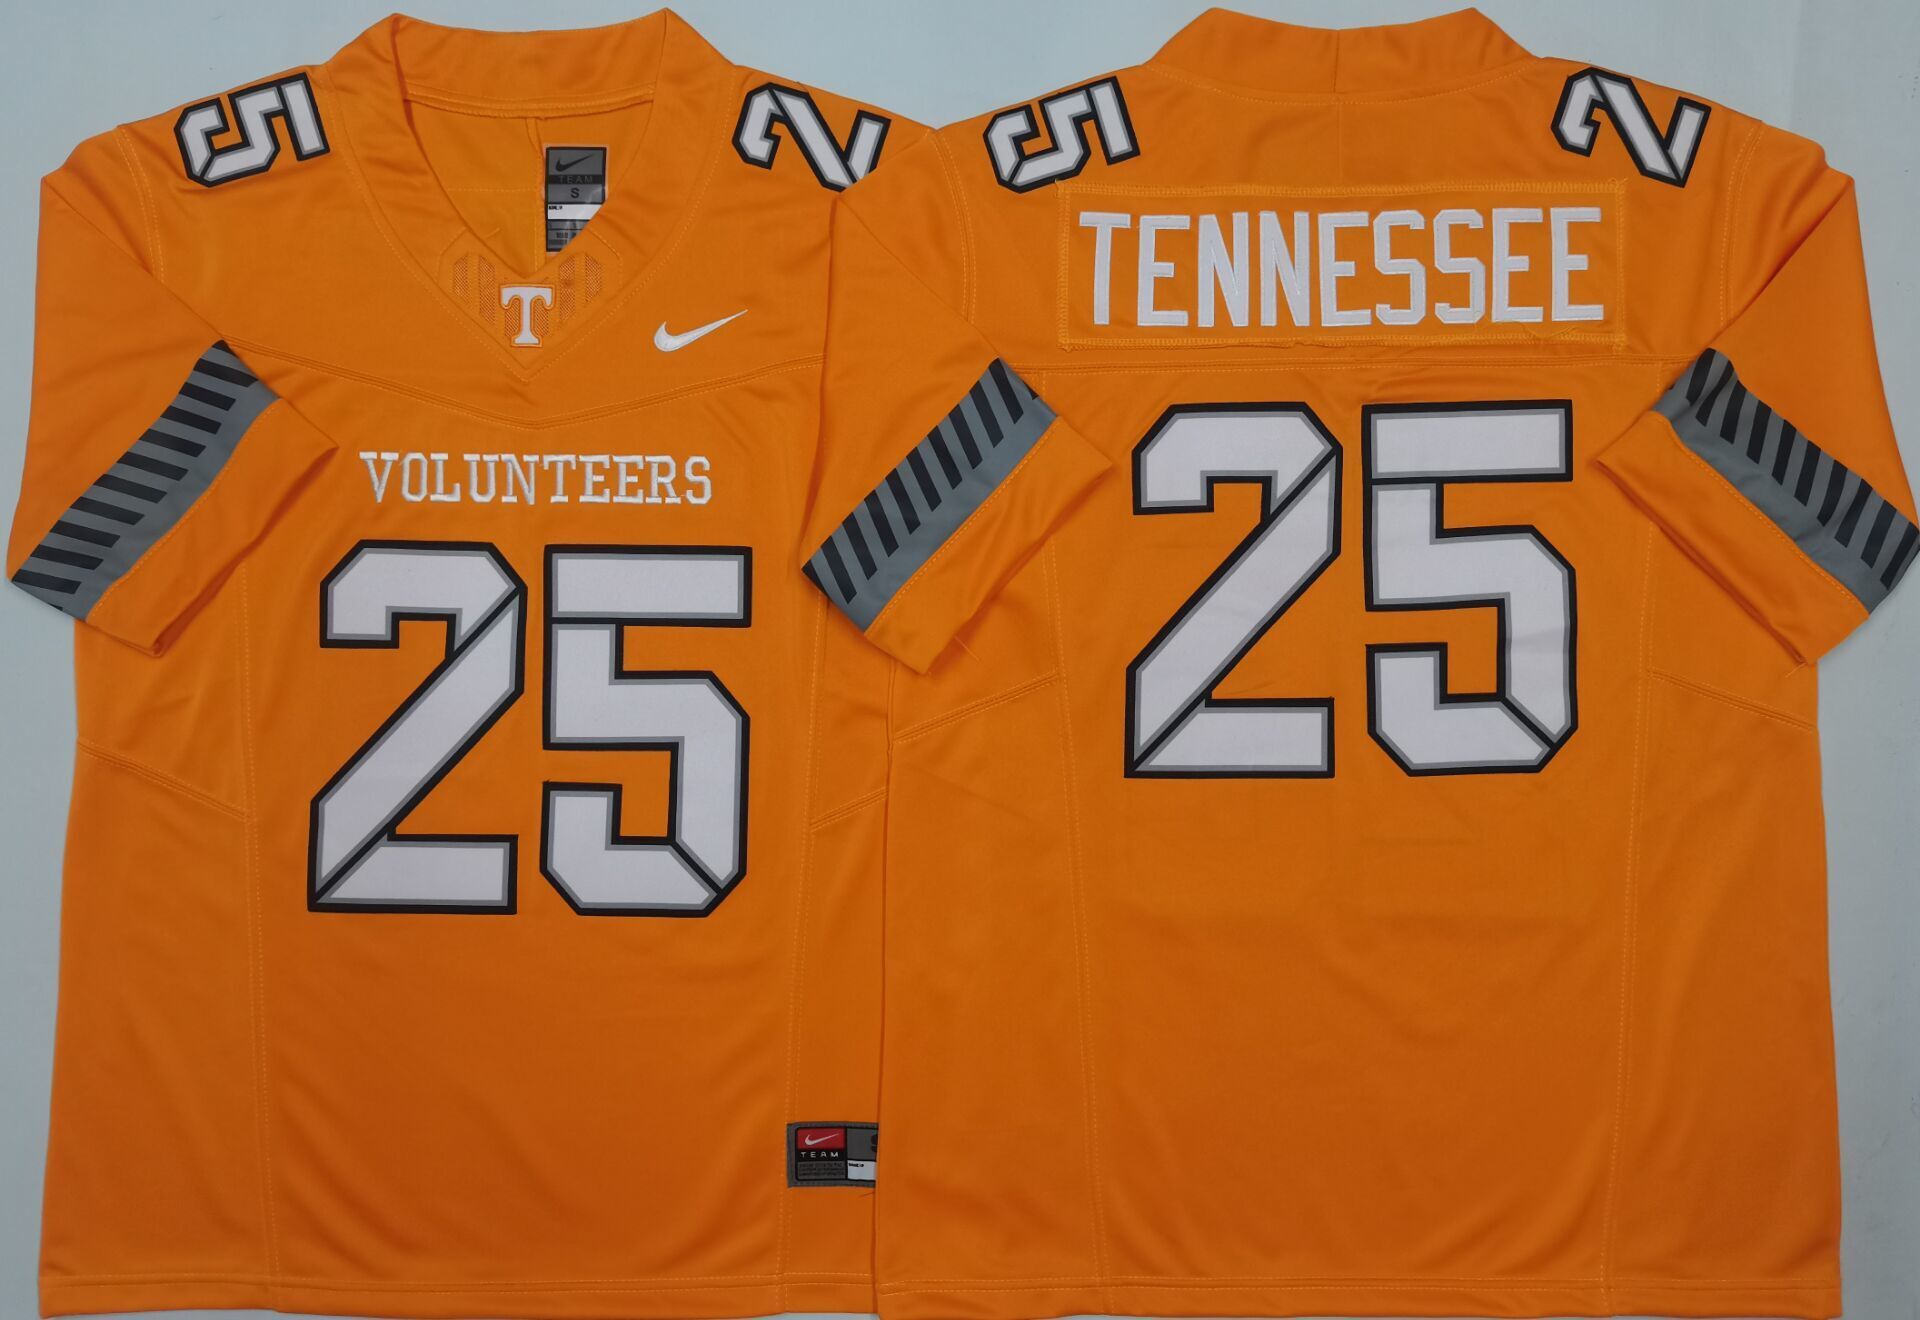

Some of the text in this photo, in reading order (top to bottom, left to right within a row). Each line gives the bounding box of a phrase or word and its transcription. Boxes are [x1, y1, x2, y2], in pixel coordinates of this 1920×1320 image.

[173, 72, 330, 188] 5
[560, 175, 593, 184] TEAM
[732, 82, 891, 193] 2
[983, 76, 1141, 193] 5
[1551, 67, 1711, 188] 2
[570, 187, 580, 199] S
[499, 284, 554, 347] T
[1079, 207, 1604, 329] TENNESSEE
[359, 451, 712, 505] VOLUNTEERS
[1124, 399, 1578, 779] 25
[307, 539, 752, 917] 25
